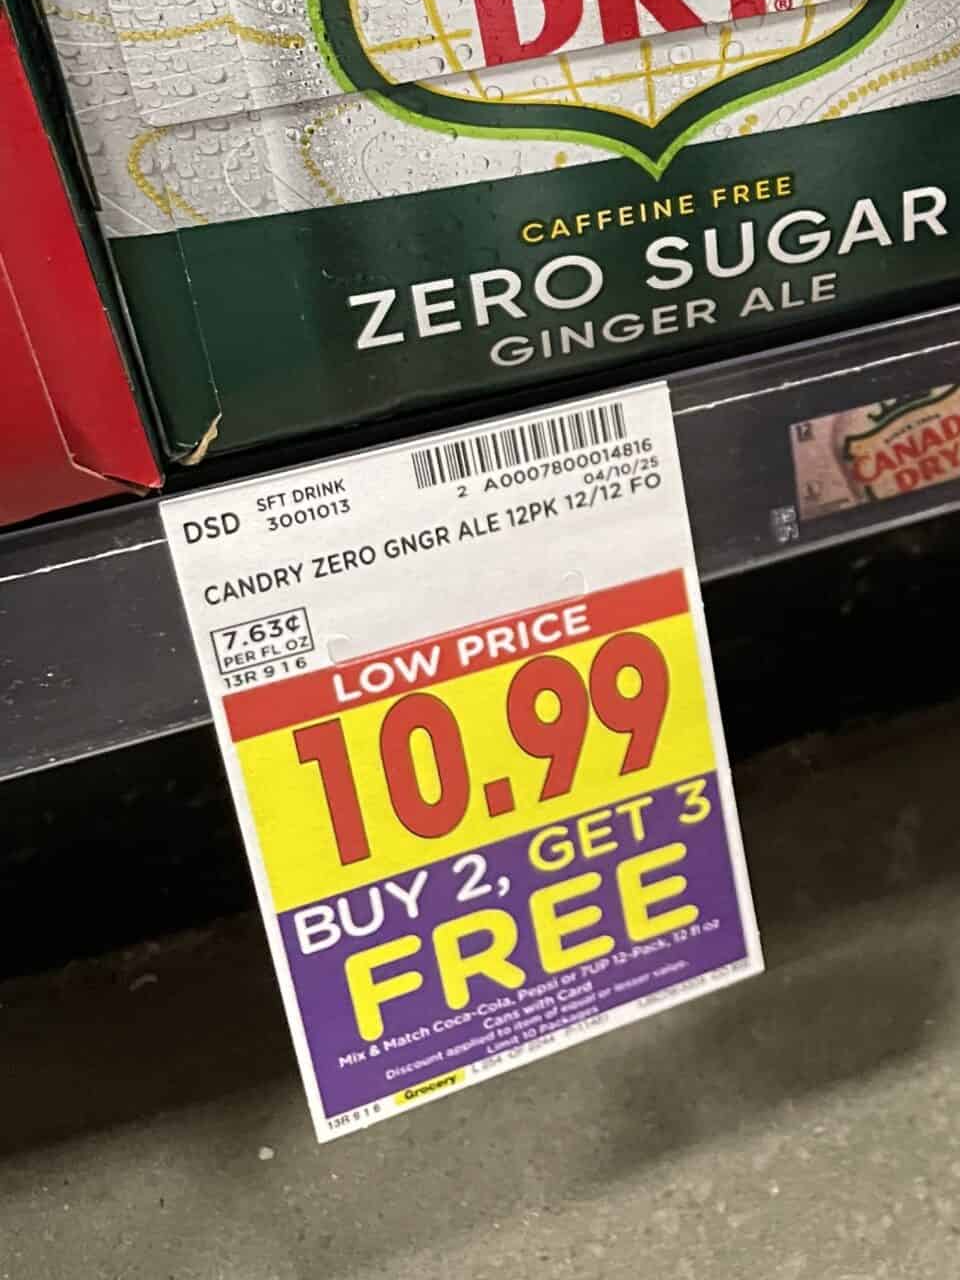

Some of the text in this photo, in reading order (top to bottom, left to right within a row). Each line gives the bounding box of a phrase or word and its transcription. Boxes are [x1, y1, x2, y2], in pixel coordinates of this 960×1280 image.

[521, 174, 795, 245] CAFFEINE FREE
[348, 183, 951, 351] ZERO SUGAR
[489, 270, 839, 371] GINGER ALE
[456, 437, 655, 499] 2 A0007800014816
[583, 455, 660, 487] 04/10/25
[256, 478, 347, 514] SFT DRINK
[267, 499, 352, 533] 3001013
[183, 511, 241, 545] DSD
[203, 473, 663, 606] CANDRY ZERO GNGR ALE 12PK 12/12 FO
[222, 615, 301, 653] 7.63¢
[222, 636, 310, 669] PER FL OZ
[332, 605, 591, 703] LOW PRICE
[223, 670, 258, 690] 13R
[293, 632, 670, 866] 10.99
[294, 778, 711, 956] BUY 2, GET 3
[344, 842, 699, 1042] FREE
[338, 1052, 367, 1069] Mix
[369, 1045, 381, 1057] &
[383, 1027, 430, 1051] Match
[518, 978, 559, 1002] Pepsi
[561, 973, 577, 987] or
[581, 959, 610, 978] 7UP
[673, 930, 688, 944] 12
[483, 1010, 521, 1030] Cans
[523, 995, 555, 1017] with
[557, 982, 593, 1002] Card
[385, 1051, 444, 1080] Discount
[446, 1032, 496, 1058] applied
[497, 1025, 512, 1038] to
[486, 1035, 520, 1055] Limit
[522, 1028, 536, 1041] 10
[404, 1074, 457, 1100] Grocery
